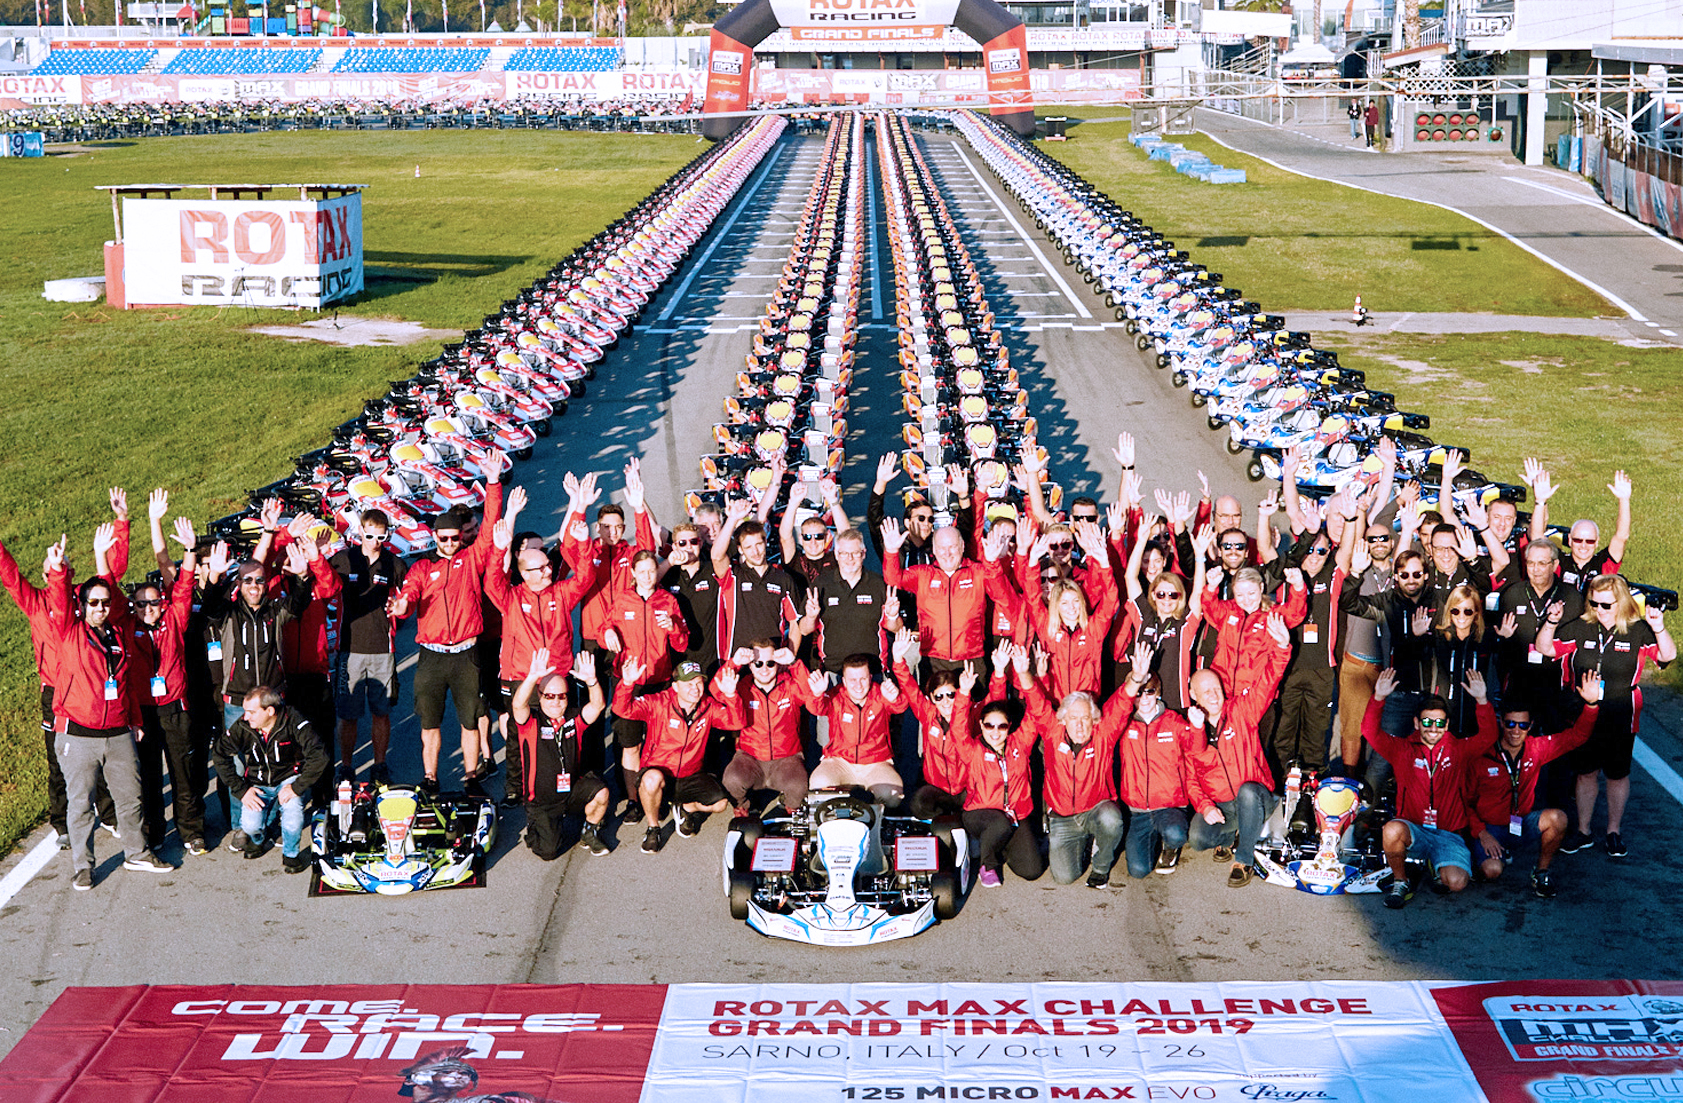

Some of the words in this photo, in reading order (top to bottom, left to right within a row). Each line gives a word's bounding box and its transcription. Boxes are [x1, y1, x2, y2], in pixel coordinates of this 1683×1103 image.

[810, 12, 917, 21] RACING
[799, 28, 863, 40] GRAND
[867, 27, 935, 39] FINALS
[0, 78, 66, 93] OTAX
[294, 81, 331, 96] GRAND
[333, 80, 370, 96] FINALS
[372, 80, 400, 96] 2019
[517, 73, 597, 90] ROTAX
[622, 72, 704, 89] ROTAX
[13, 134, 25, 156] 9
[180, 206, 352, 265] ROTAX
[182, 268, 352, 298] RACING
[713, 999, 890, 1017] ROTAX
[906, 999, 1029, 1016] MAX
[1044, 998, 1372, 1016] CHALLENGE
[1510, 1003, 1618, 1013] ROTAX
[708, 1019, 902, 1036] GRAND
[920, 1019, 1120, 1036] FINALS
[1137, 1018, 1255, 1035] 2019
[702, 1044, 851, 1060] SARNO,
[867, 1044, 966, 1059] ITALY
[976, 1044, 991, 1059] /
[1003, 1045, 1063, 1058] Oct
[1079, 1044, 1117, 1058] 19
[1163, 1044, 1206, 1058] 26
[1534, 1045, 1599, 1057] GRAND
[1603, 1045, 1671, 1057] FINALS
[842, 1087, 905, 1100] 125
[916, 1087, 1039, 1100] MICRO
[1050, 1086, 1137, 1100] MAX
[1148, 1086, 1217, 1100] EVO
